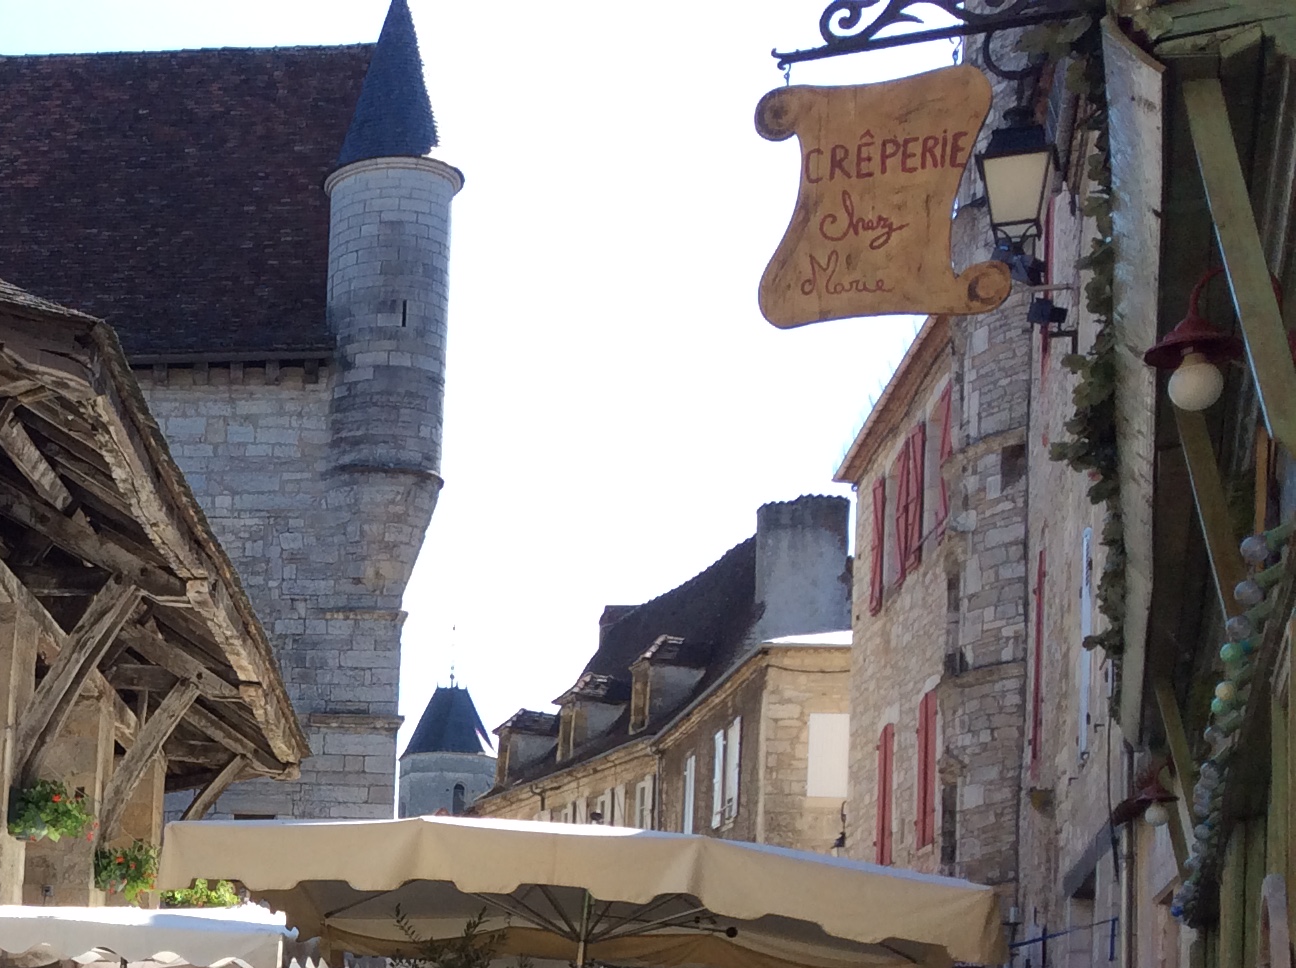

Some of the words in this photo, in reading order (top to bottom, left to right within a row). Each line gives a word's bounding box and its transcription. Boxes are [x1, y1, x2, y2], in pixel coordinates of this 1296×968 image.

[806, 129, 968, 184] CRÊPERIE
[819, 190, 908, 250] Chez
[801, 250, 893, 296] Marie
